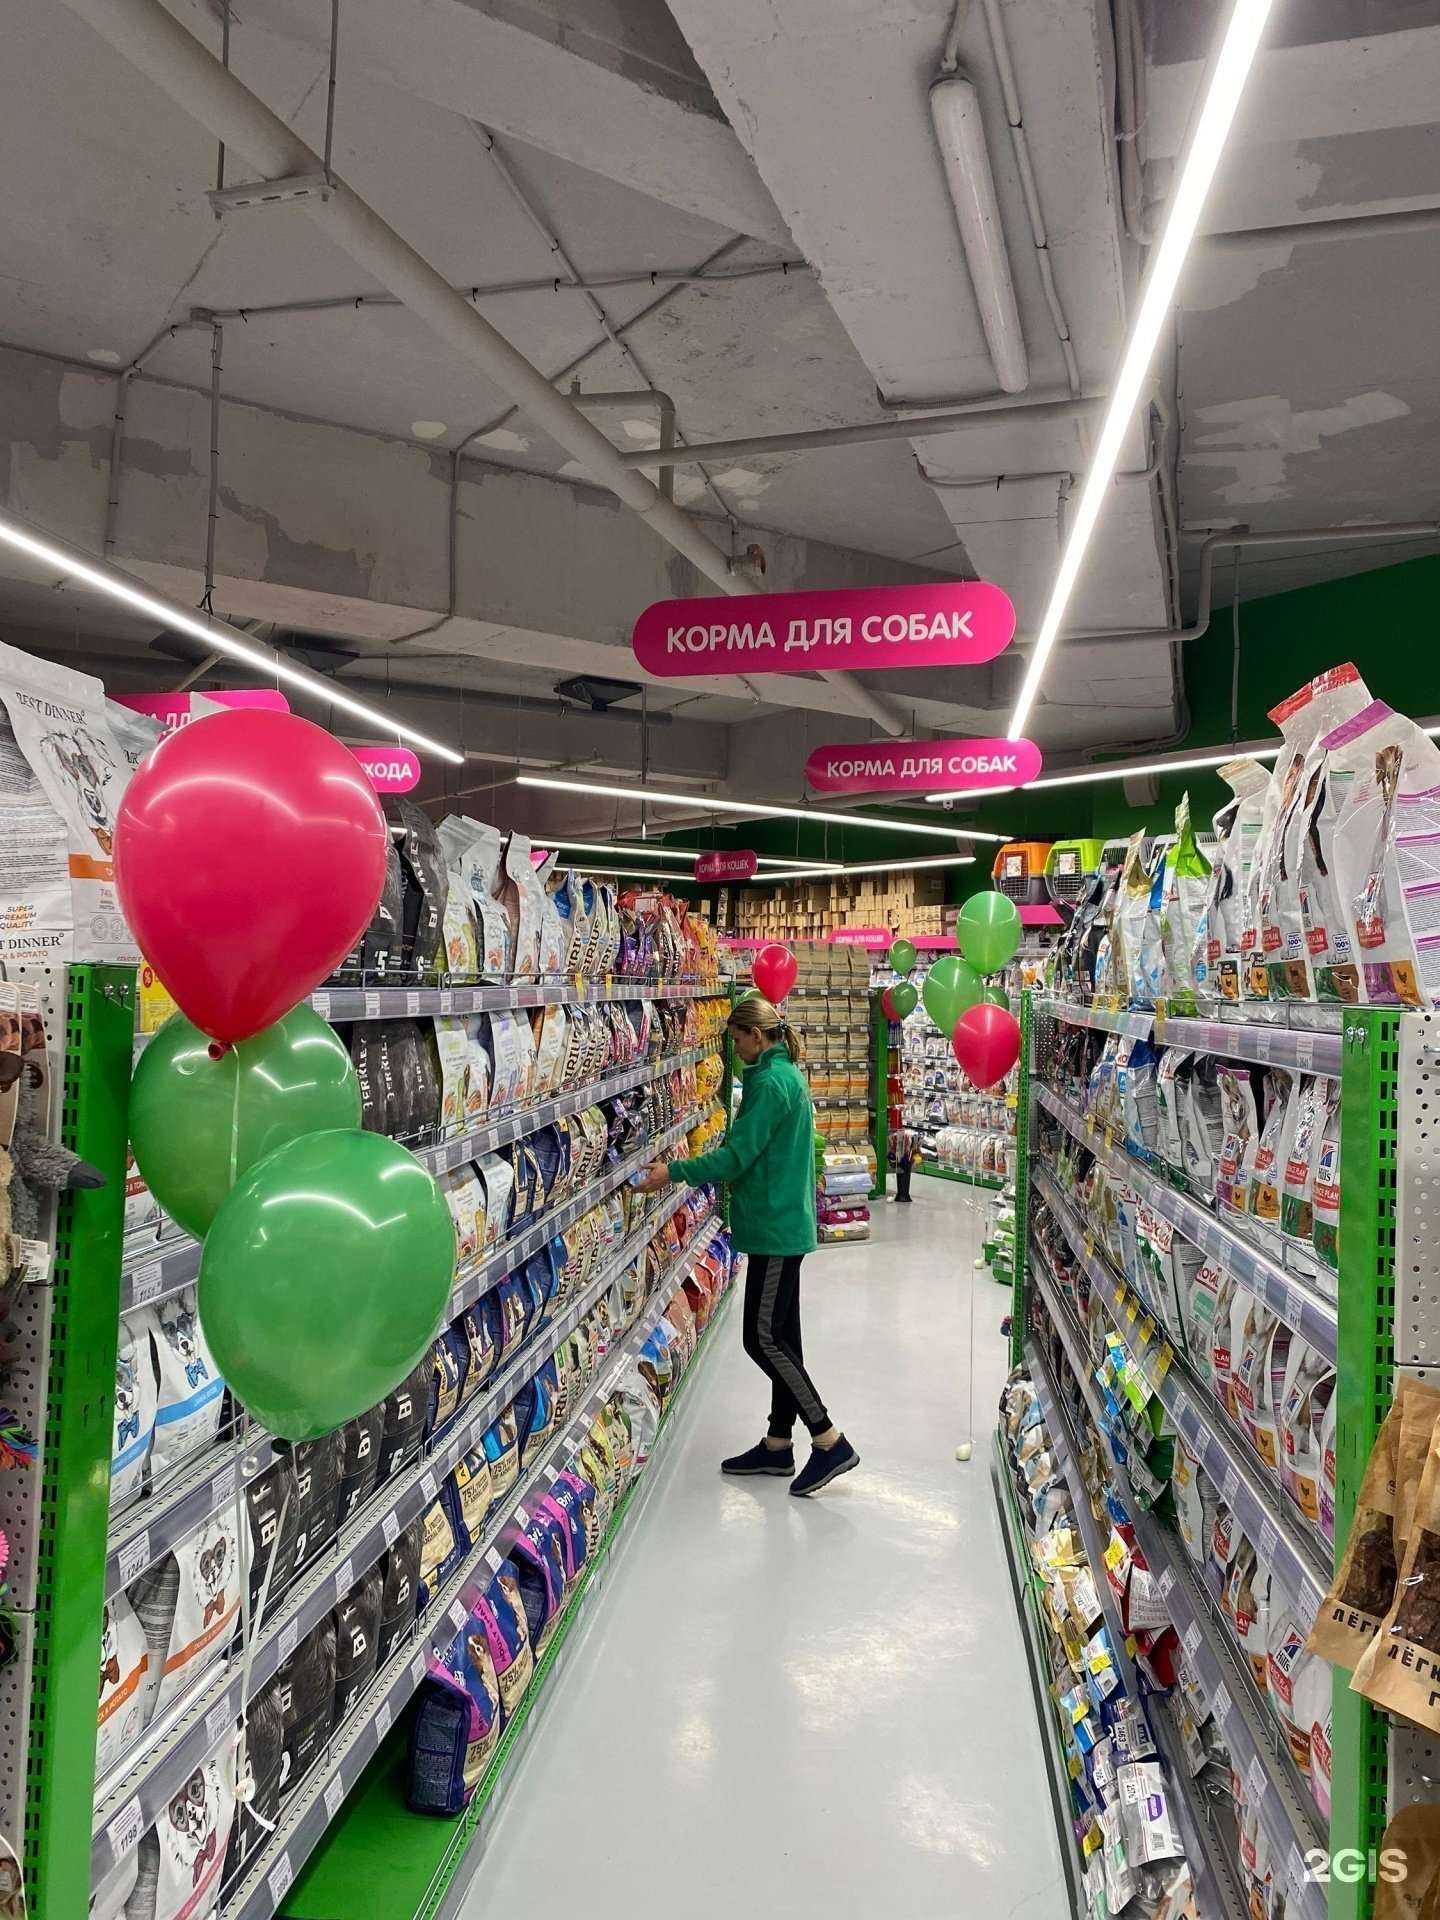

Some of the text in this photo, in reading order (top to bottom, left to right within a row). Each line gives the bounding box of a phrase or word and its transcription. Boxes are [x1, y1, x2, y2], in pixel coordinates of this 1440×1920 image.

[667, 610, 975, 653] КОРМА ДЛЯ СОБАК
[362, 762, 413, 782] ХОДА
[827, 755, 1018, 779] КОРМА ДЛЯ СОБАК
[7, 904, 34, 913] SUPER
[8, 935, 62, 950] DINNER
[16, 950, 48, 959] POTATO
[119, 1826, 139, 1852] 1198
